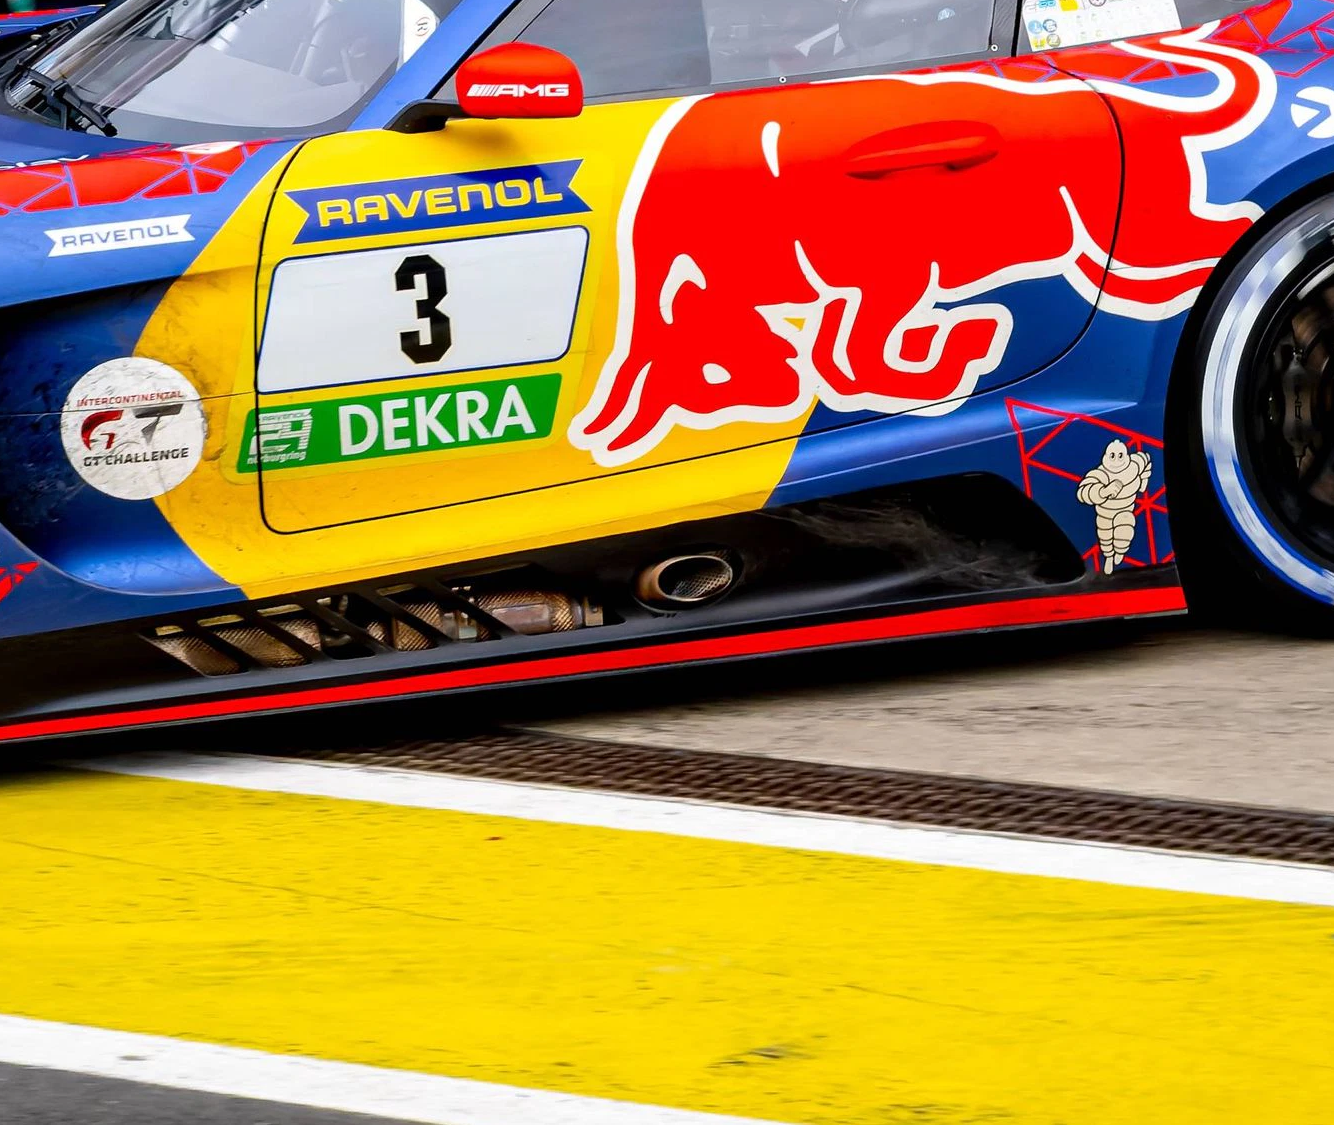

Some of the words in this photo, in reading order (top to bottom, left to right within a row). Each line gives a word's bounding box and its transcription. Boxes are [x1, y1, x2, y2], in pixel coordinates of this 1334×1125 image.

[493, 83, 570, 98] AMG
[317, 177, 564, 227] RAVENOL
[61, 224, 179, 249] RAVENOL
[393, 254, 453, 364] 3
[76, 390, 185, 408] INTERCONTINENTAL
[339, 384, 536, 456] DEKRA
[83, 455, 103, 467] GT
[106, 447, 190, 466] CHALLENGE
